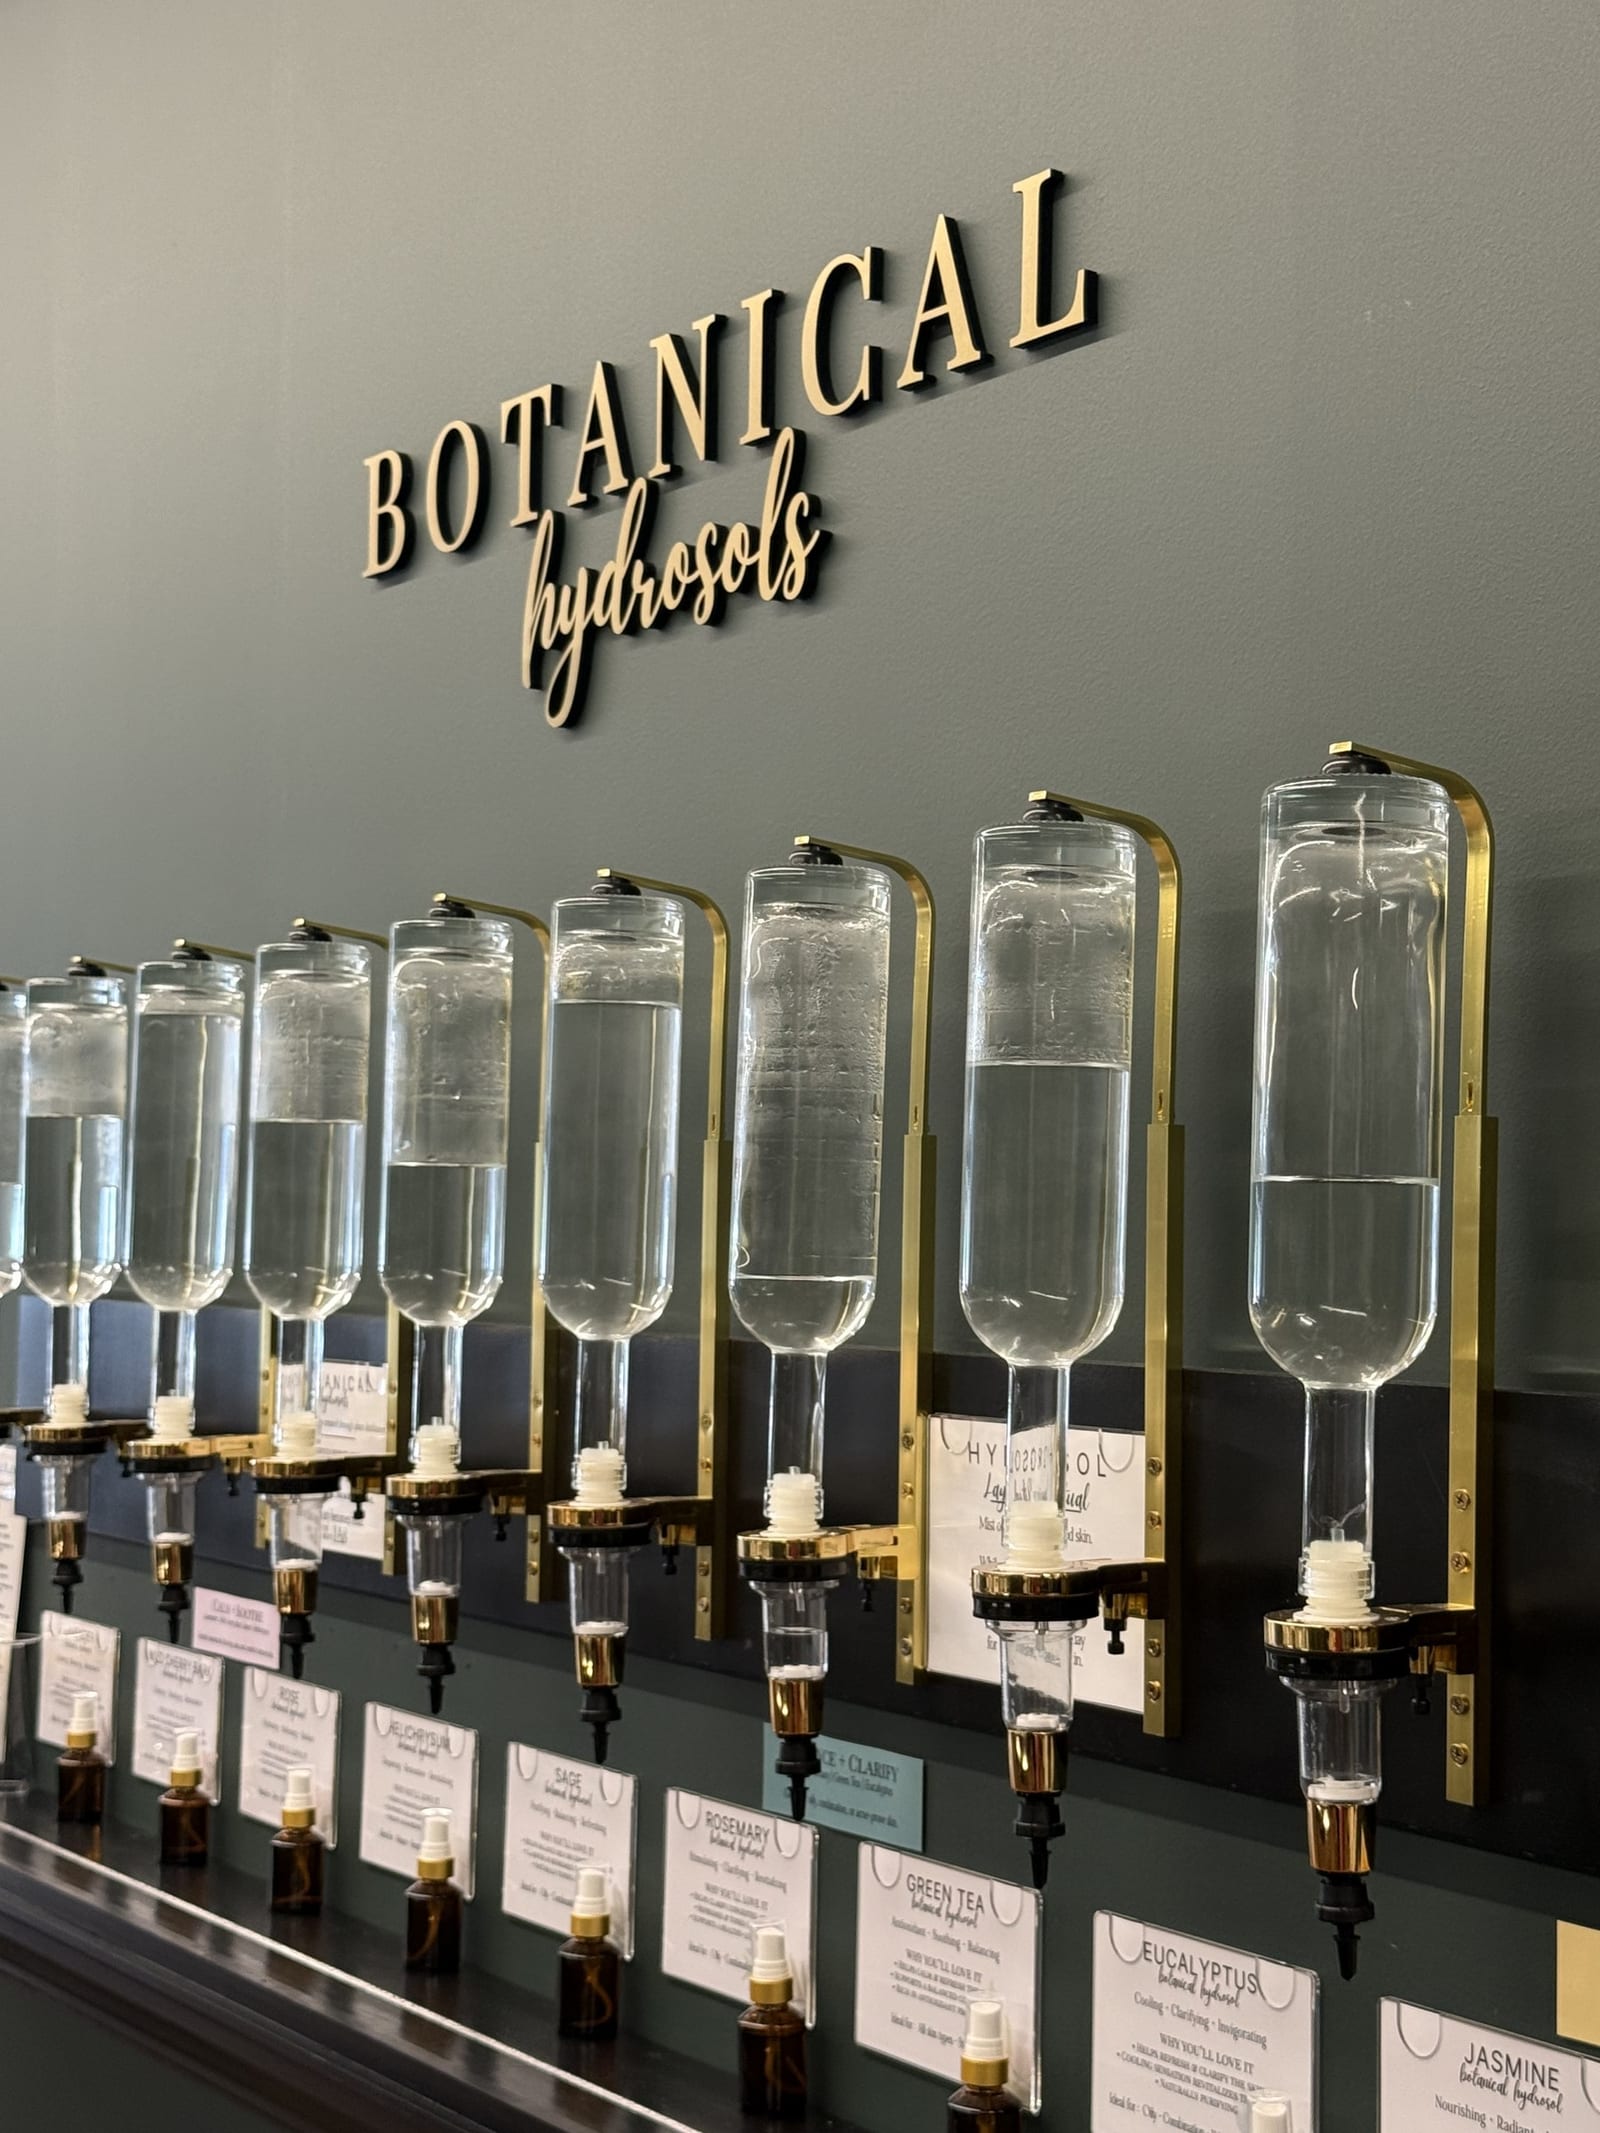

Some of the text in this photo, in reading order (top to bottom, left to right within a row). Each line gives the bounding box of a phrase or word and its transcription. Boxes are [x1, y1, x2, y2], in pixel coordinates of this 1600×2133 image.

[363, 168, 1096, 579] BOTANICAL
[522, 428, 830, 727] hydrosols
[555, 1767, 581, 1789] SAGE
[848, 1754, 899, 1784] CLARIFY
[706, 1811, 770, 1843] ROSEMARY
[906, 1873, 984, 1914] GREEN TEA
[1143, 1940, 1257, 1994] EUCALYPTUS
[1134, 1991, 1267, 2051] Cooling Clarifying Invigorating
[1160, 2033, 1254, 2075] WHY YOU'LL LOVE IT
[1463, 2042, 1559, 2092] JASMINE
[1459, 2062, 1563, 2114] botanical hydrosol
[1435, 2094, 1486, 2129] Nourishing
